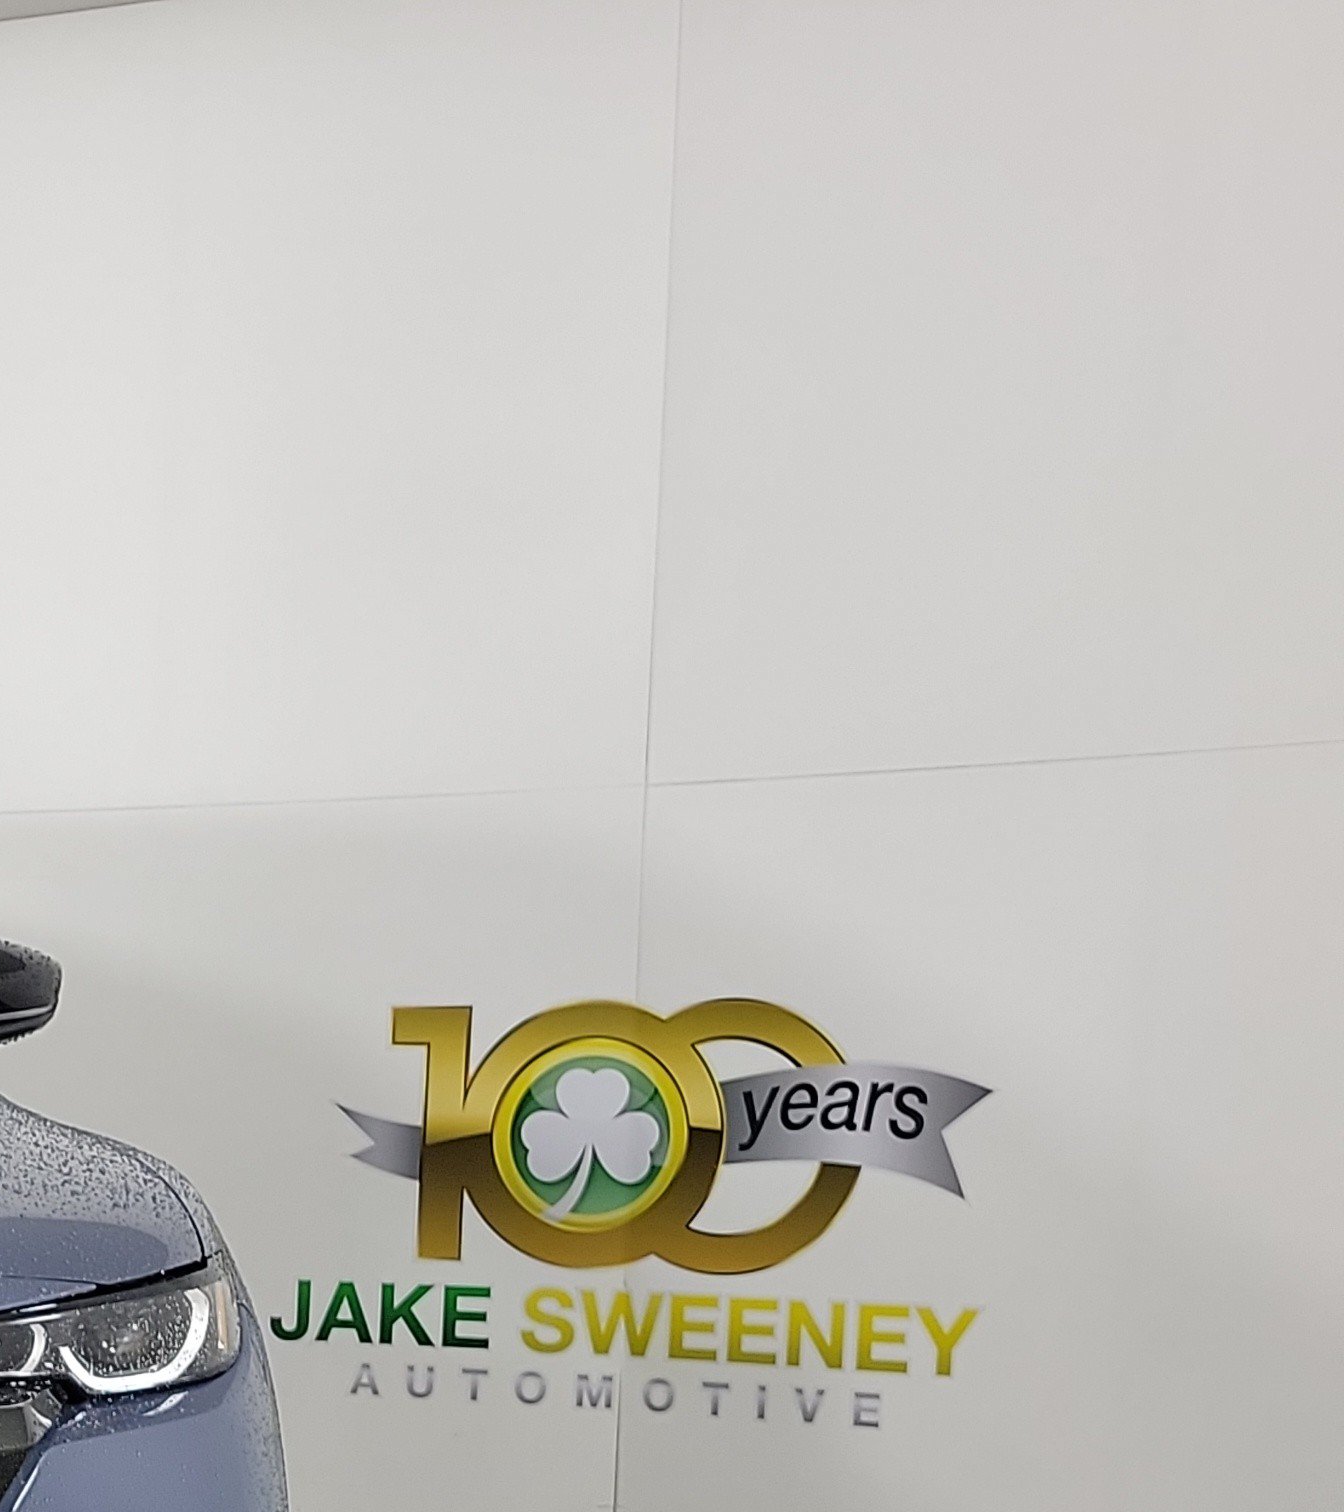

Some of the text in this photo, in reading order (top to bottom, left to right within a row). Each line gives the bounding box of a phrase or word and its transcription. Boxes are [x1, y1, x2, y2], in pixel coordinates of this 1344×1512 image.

[738, 1079, 929, 1151] years
[269, 1279, 979, 1377] JAKE SWEENEY
[349, 1362, 882, 1429] AUTOMOTIVE
